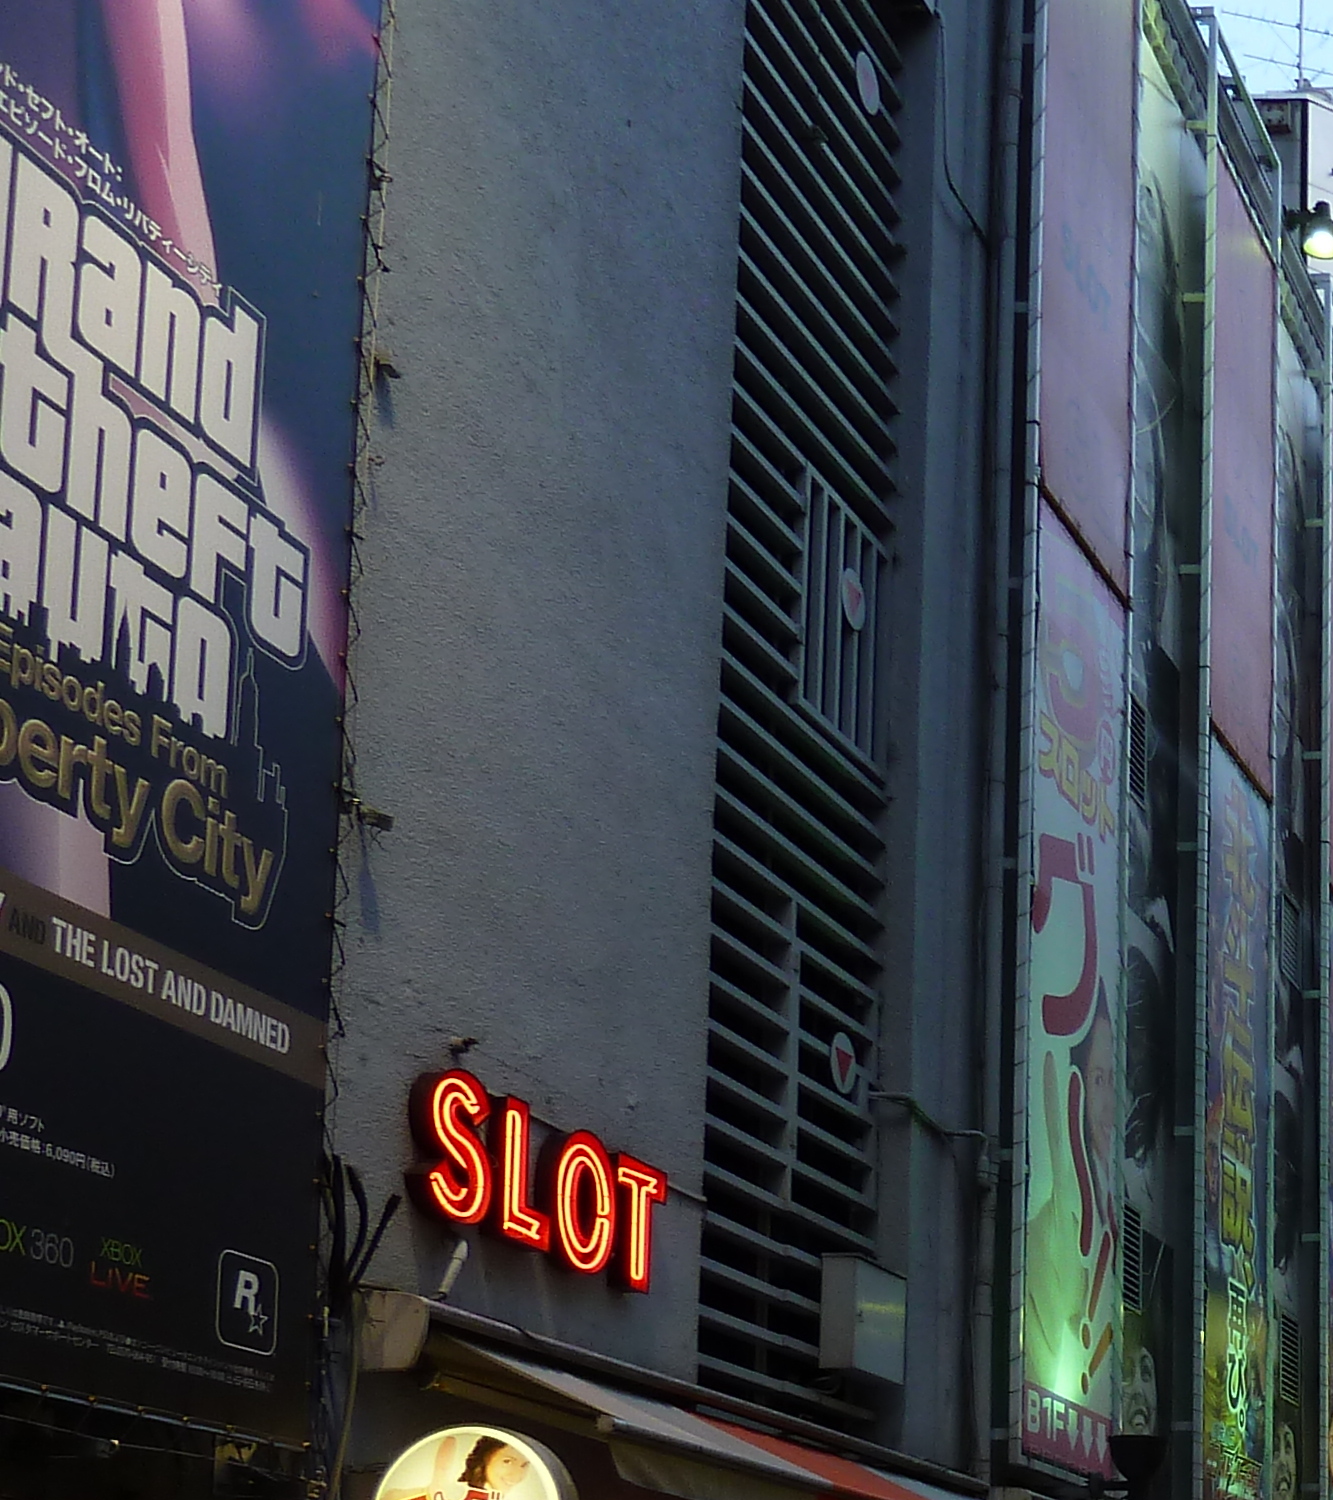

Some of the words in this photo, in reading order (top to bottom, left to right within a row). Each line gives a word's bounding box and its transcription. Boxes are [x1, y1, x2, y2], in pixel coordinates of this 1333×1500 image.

[150, 720, 228, 796] From
[161, 777, 273, 915] City
[52, 917, 96, 968] THE
[102, 945, 159, 995] LOST
[162, 970, 206, 1018] AND
[210, 995, 290, 1056] DAMNED
[428, 1067, 667, 1293] SLOT
[31, 1229, 74, 1269] 360
[90, 1261, 151, 1299] LIVE
[100, 1236, 142, 1267] XBOX
